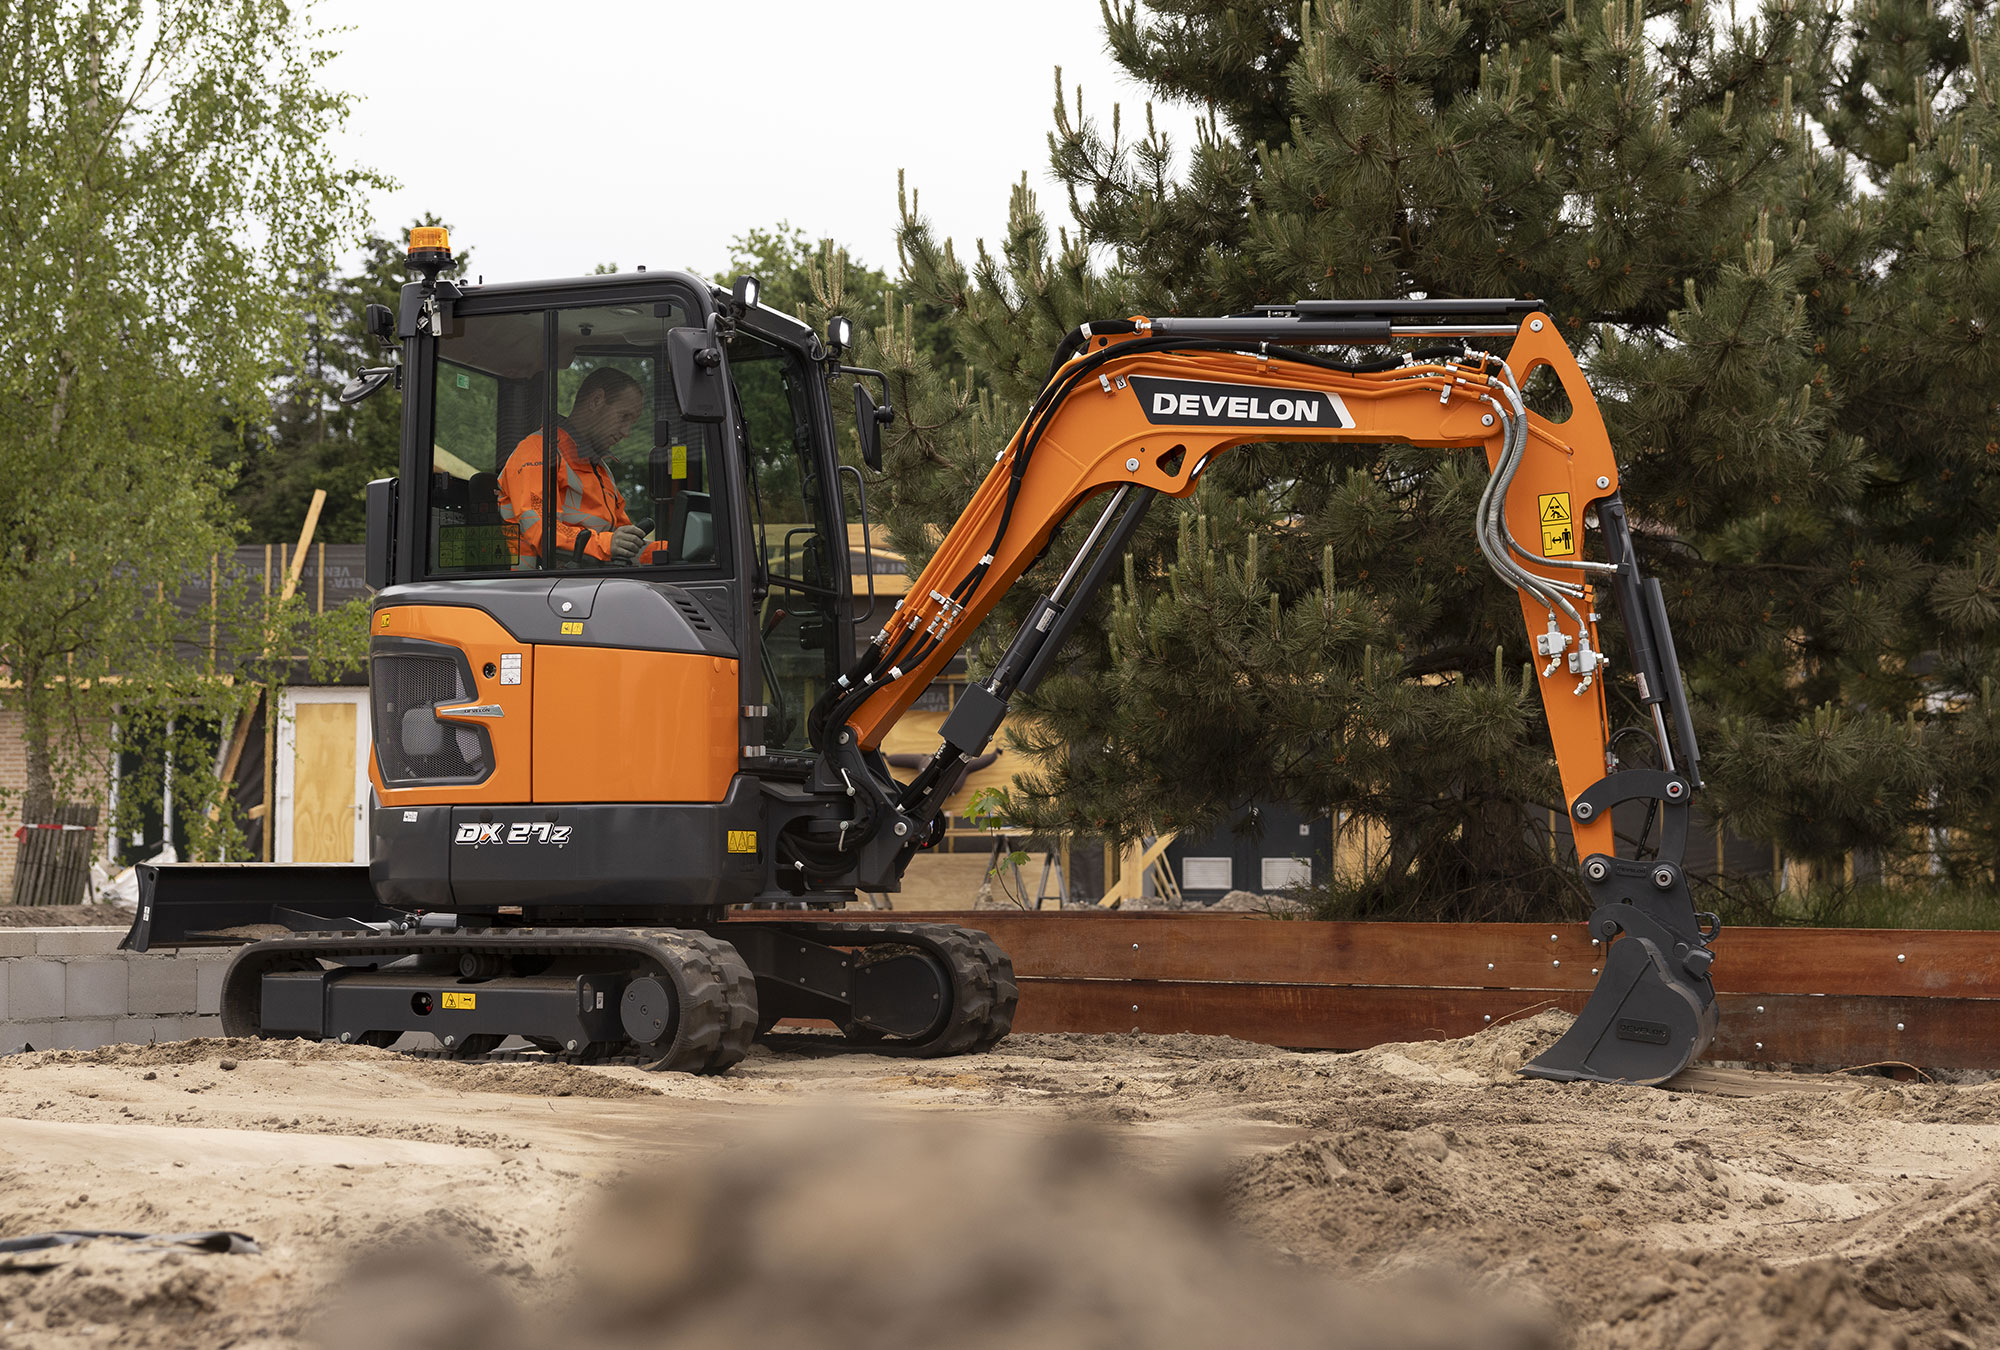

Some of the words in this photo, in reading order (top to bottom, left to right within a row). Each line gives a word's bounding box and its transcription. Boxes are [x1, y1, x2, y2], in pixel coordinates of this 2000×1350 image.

[1152, 392, 1319, 422] DEVELON
[454, 822, 505, 845] DX
[1619, 1023, 1666, 1037] DEVELON
